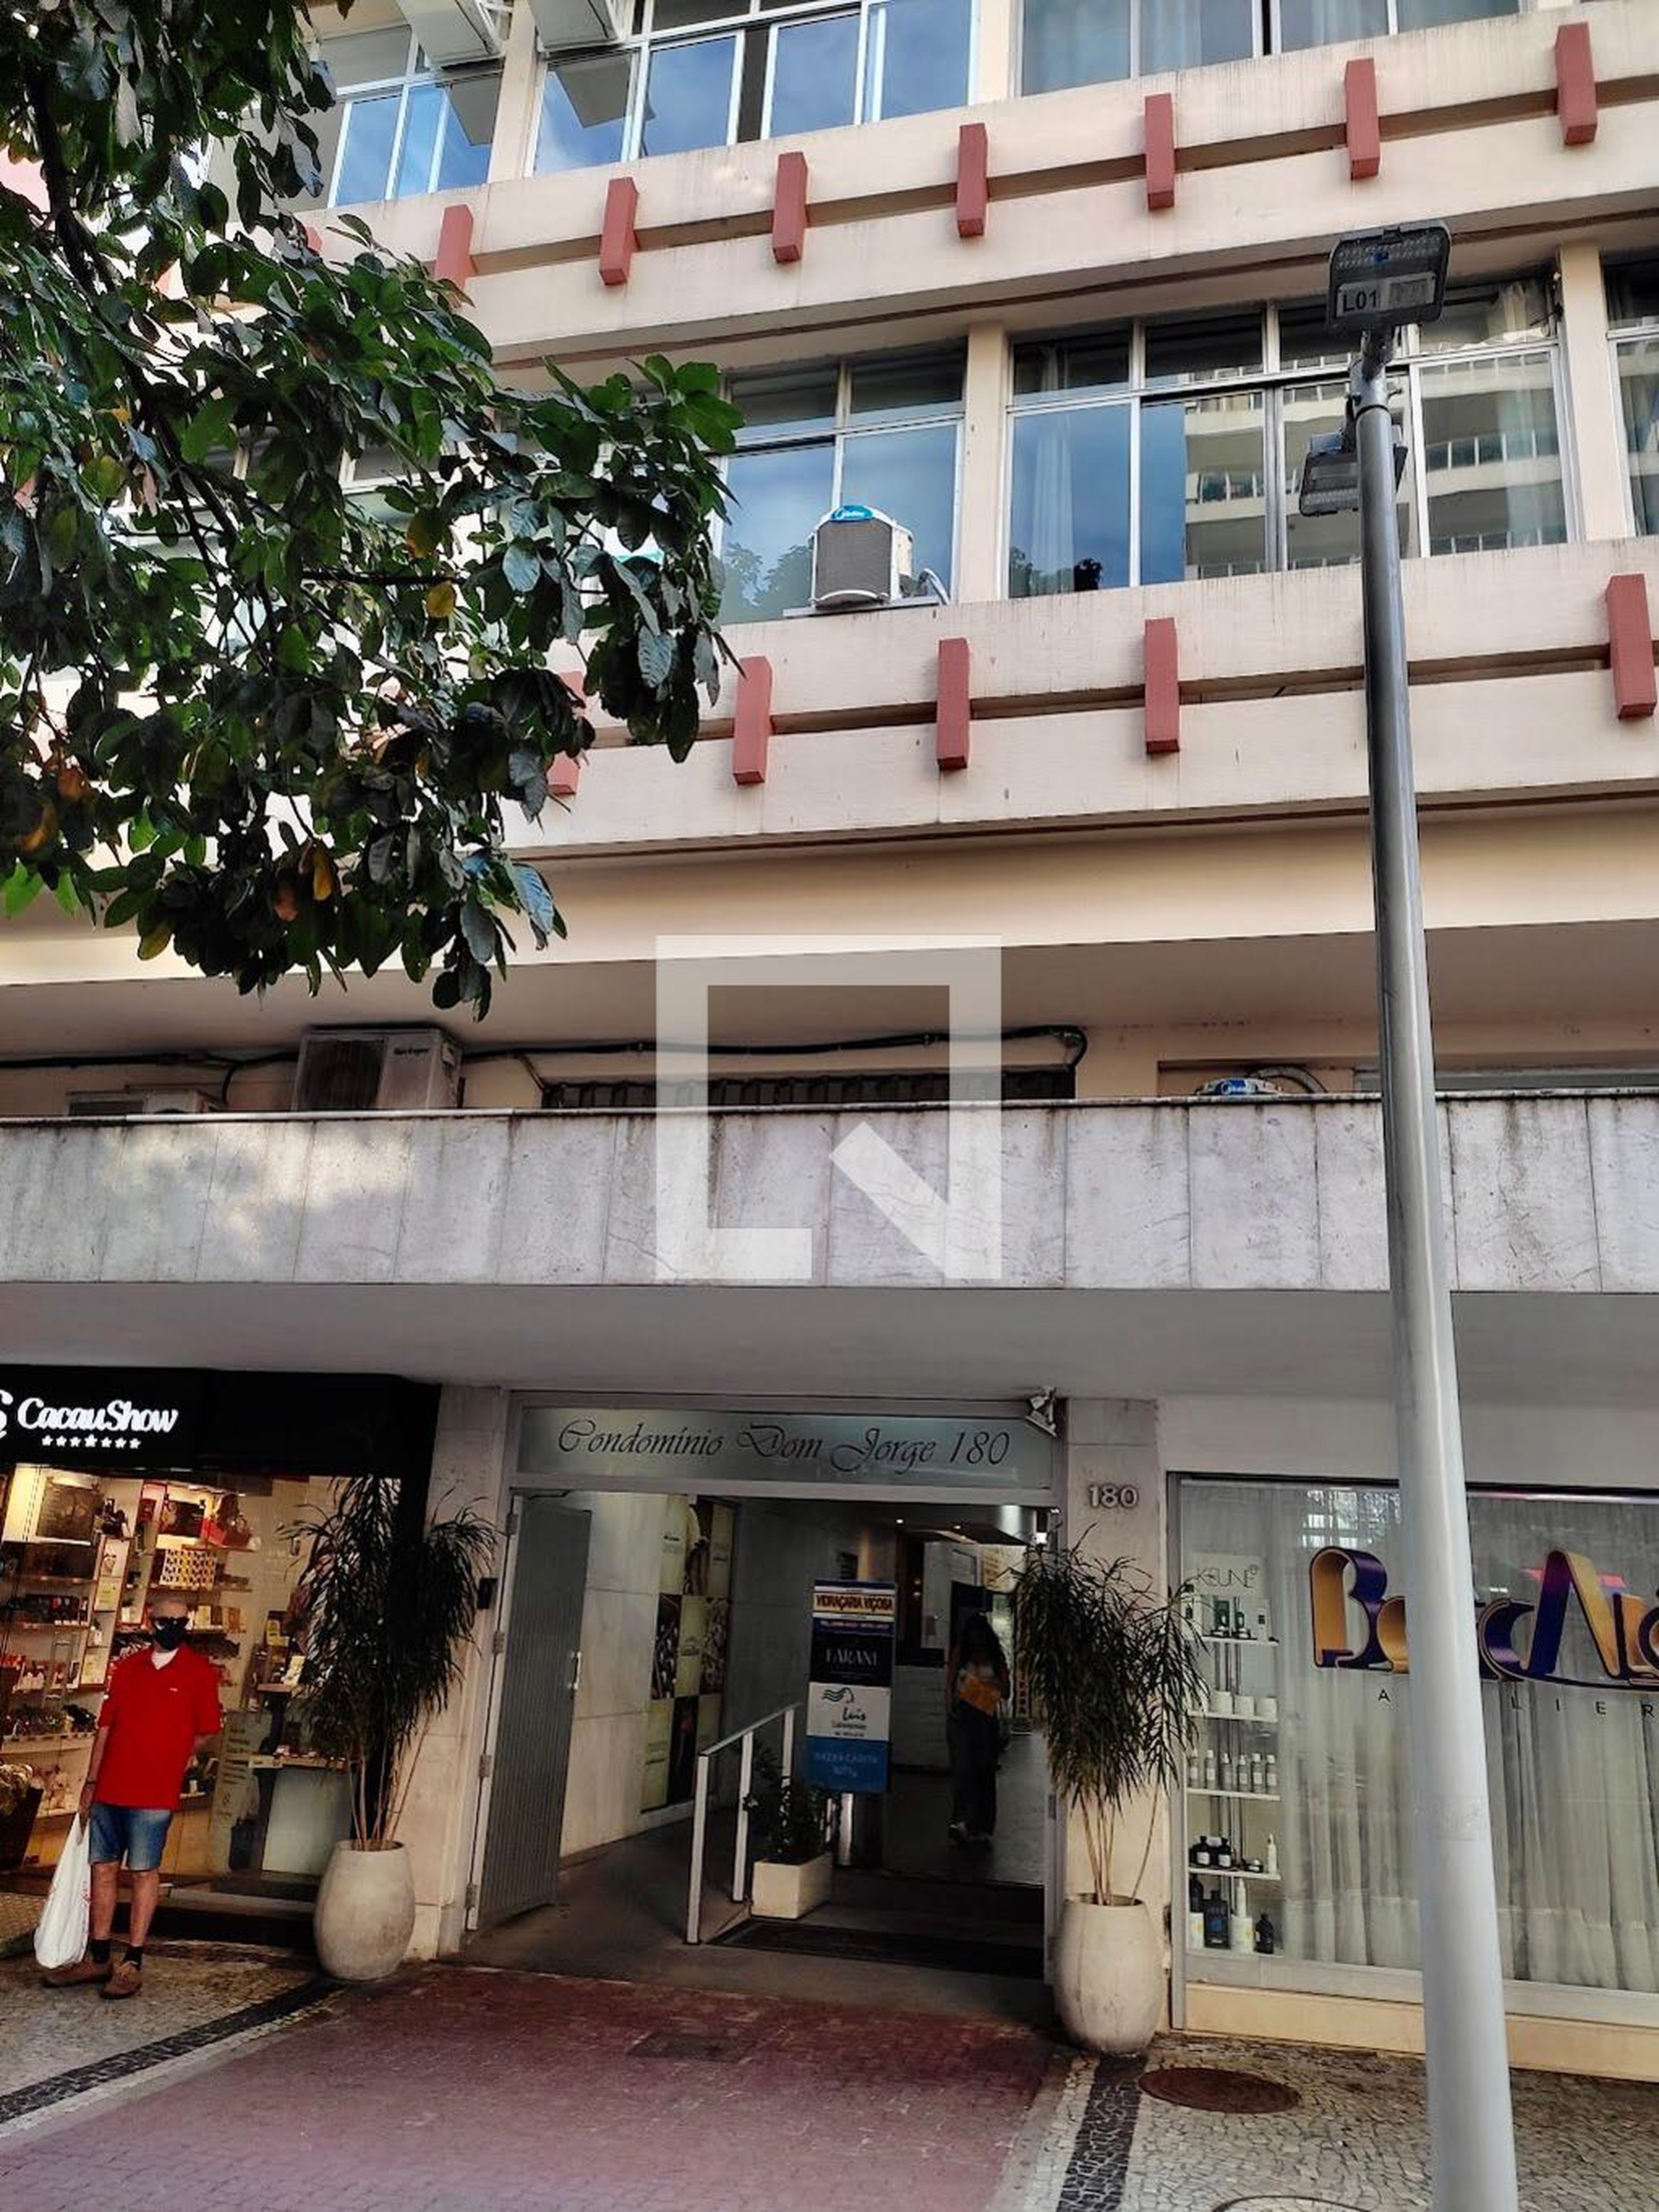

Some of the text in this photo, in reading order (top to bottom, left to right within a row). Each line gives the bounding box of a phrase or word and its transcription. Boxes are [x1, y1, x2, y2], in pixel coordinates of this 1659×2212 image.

[1343, 290, 1376, 312] L01
[558, 1418, 1010, 1475] Condomínio Dom Jorge 180
[1088, 1485, 1139, 1508] 180
